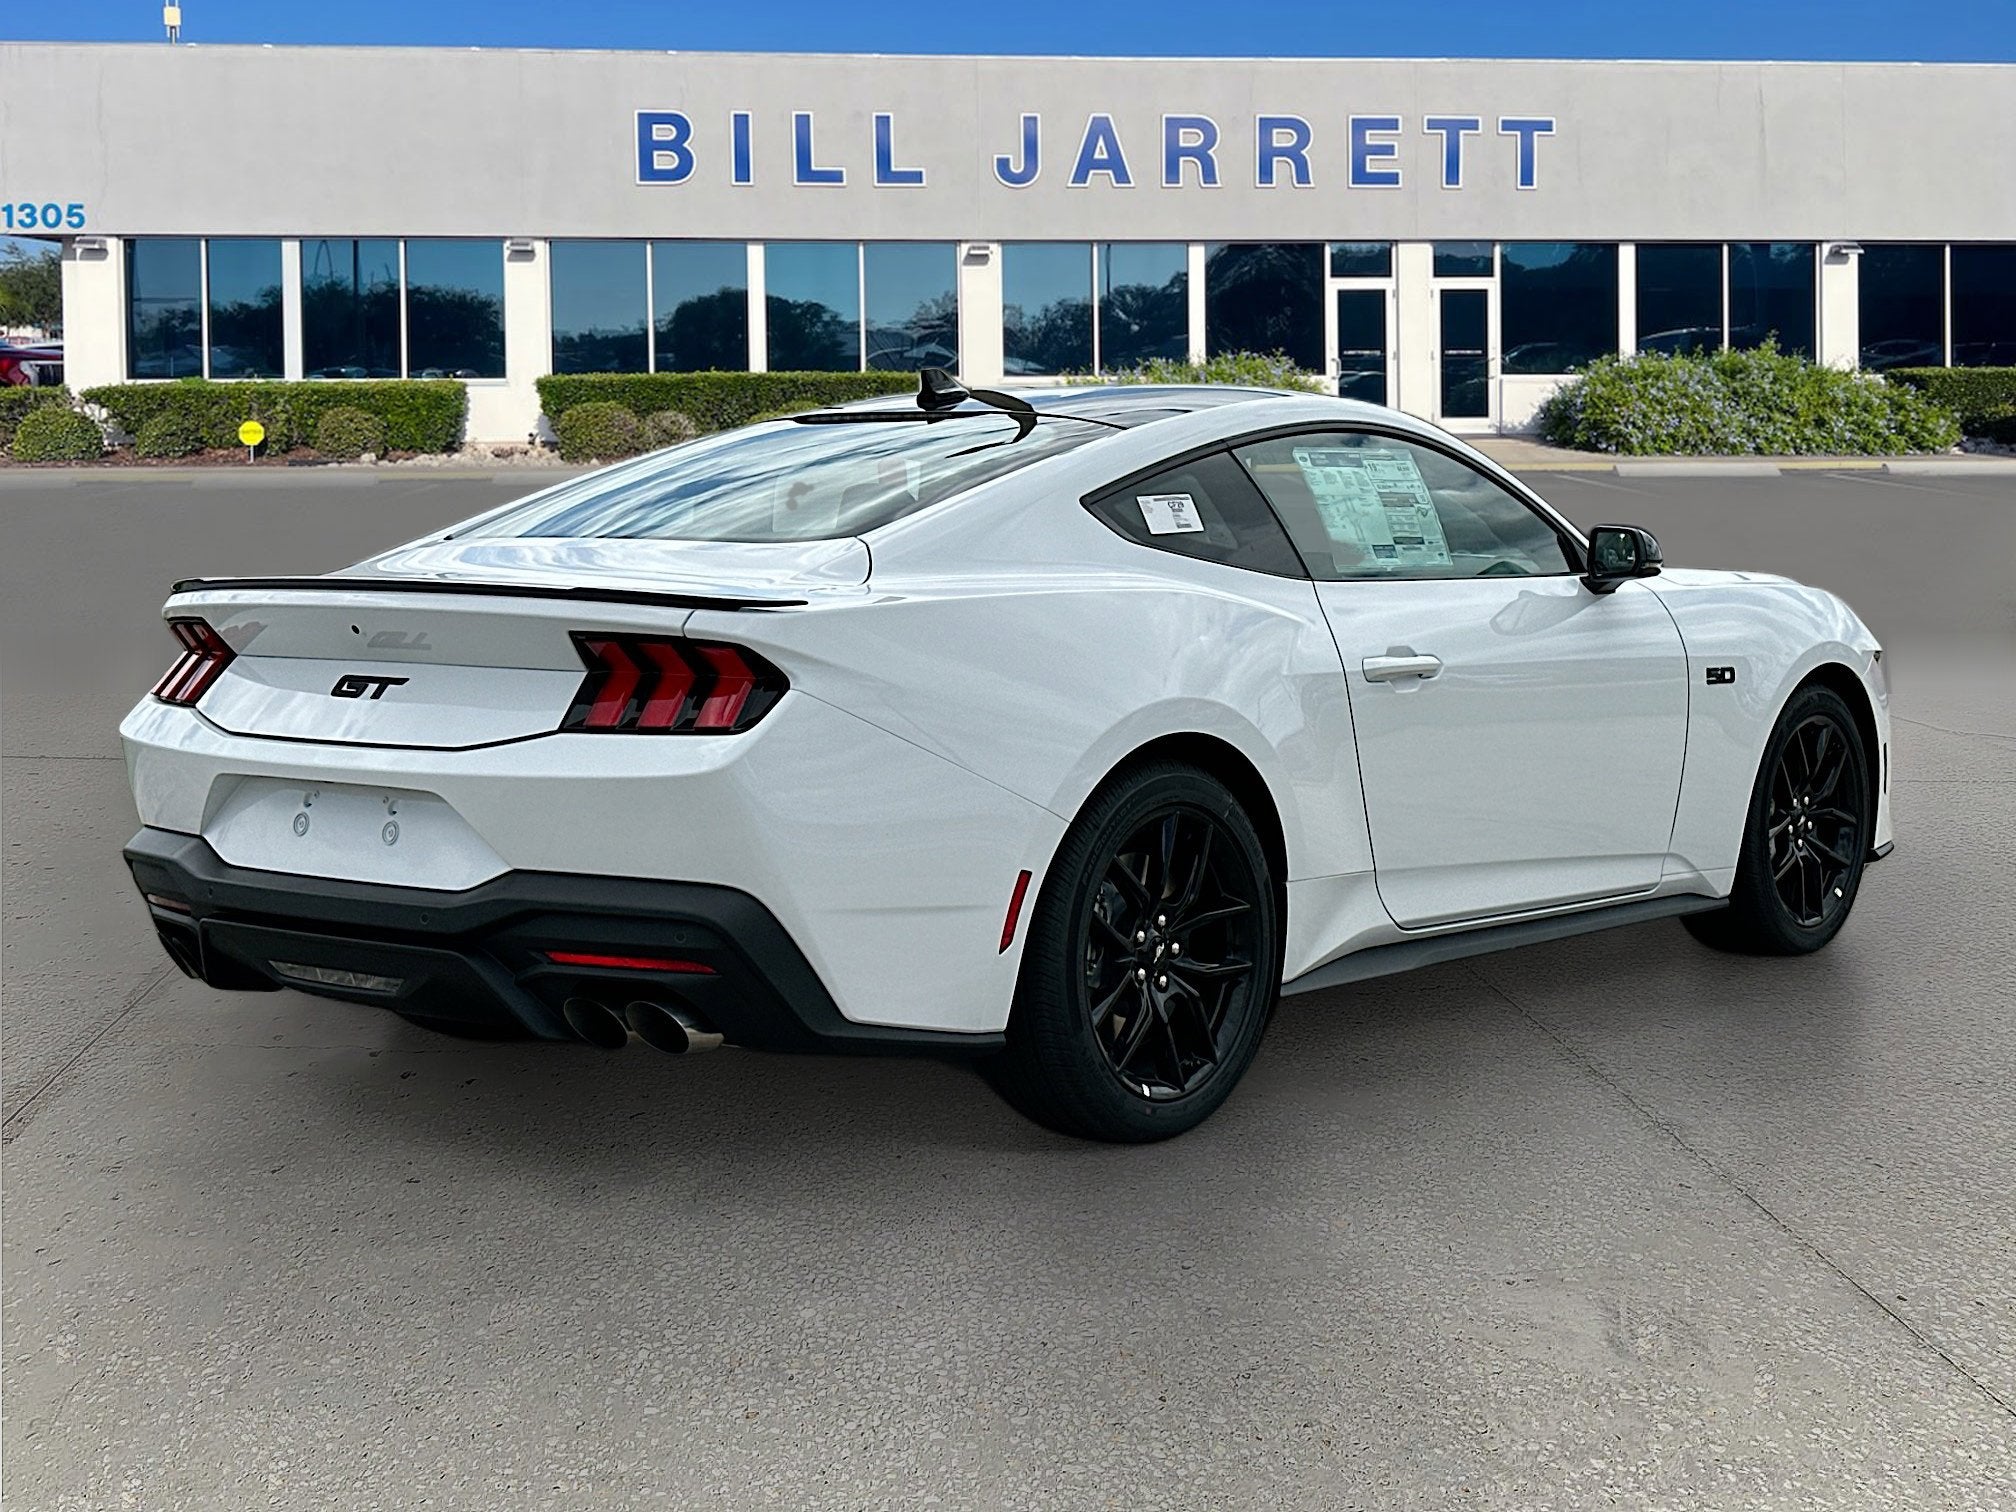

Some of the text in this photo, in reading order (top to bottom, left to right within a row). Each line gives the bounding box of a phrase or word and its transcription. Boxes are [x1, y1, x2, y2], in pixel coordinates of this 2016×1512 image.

[636, 110, 1556, 189] BILL JARRETT
[0, 202, 87, 229] 1305
[330, 674, 410, 700] GT
